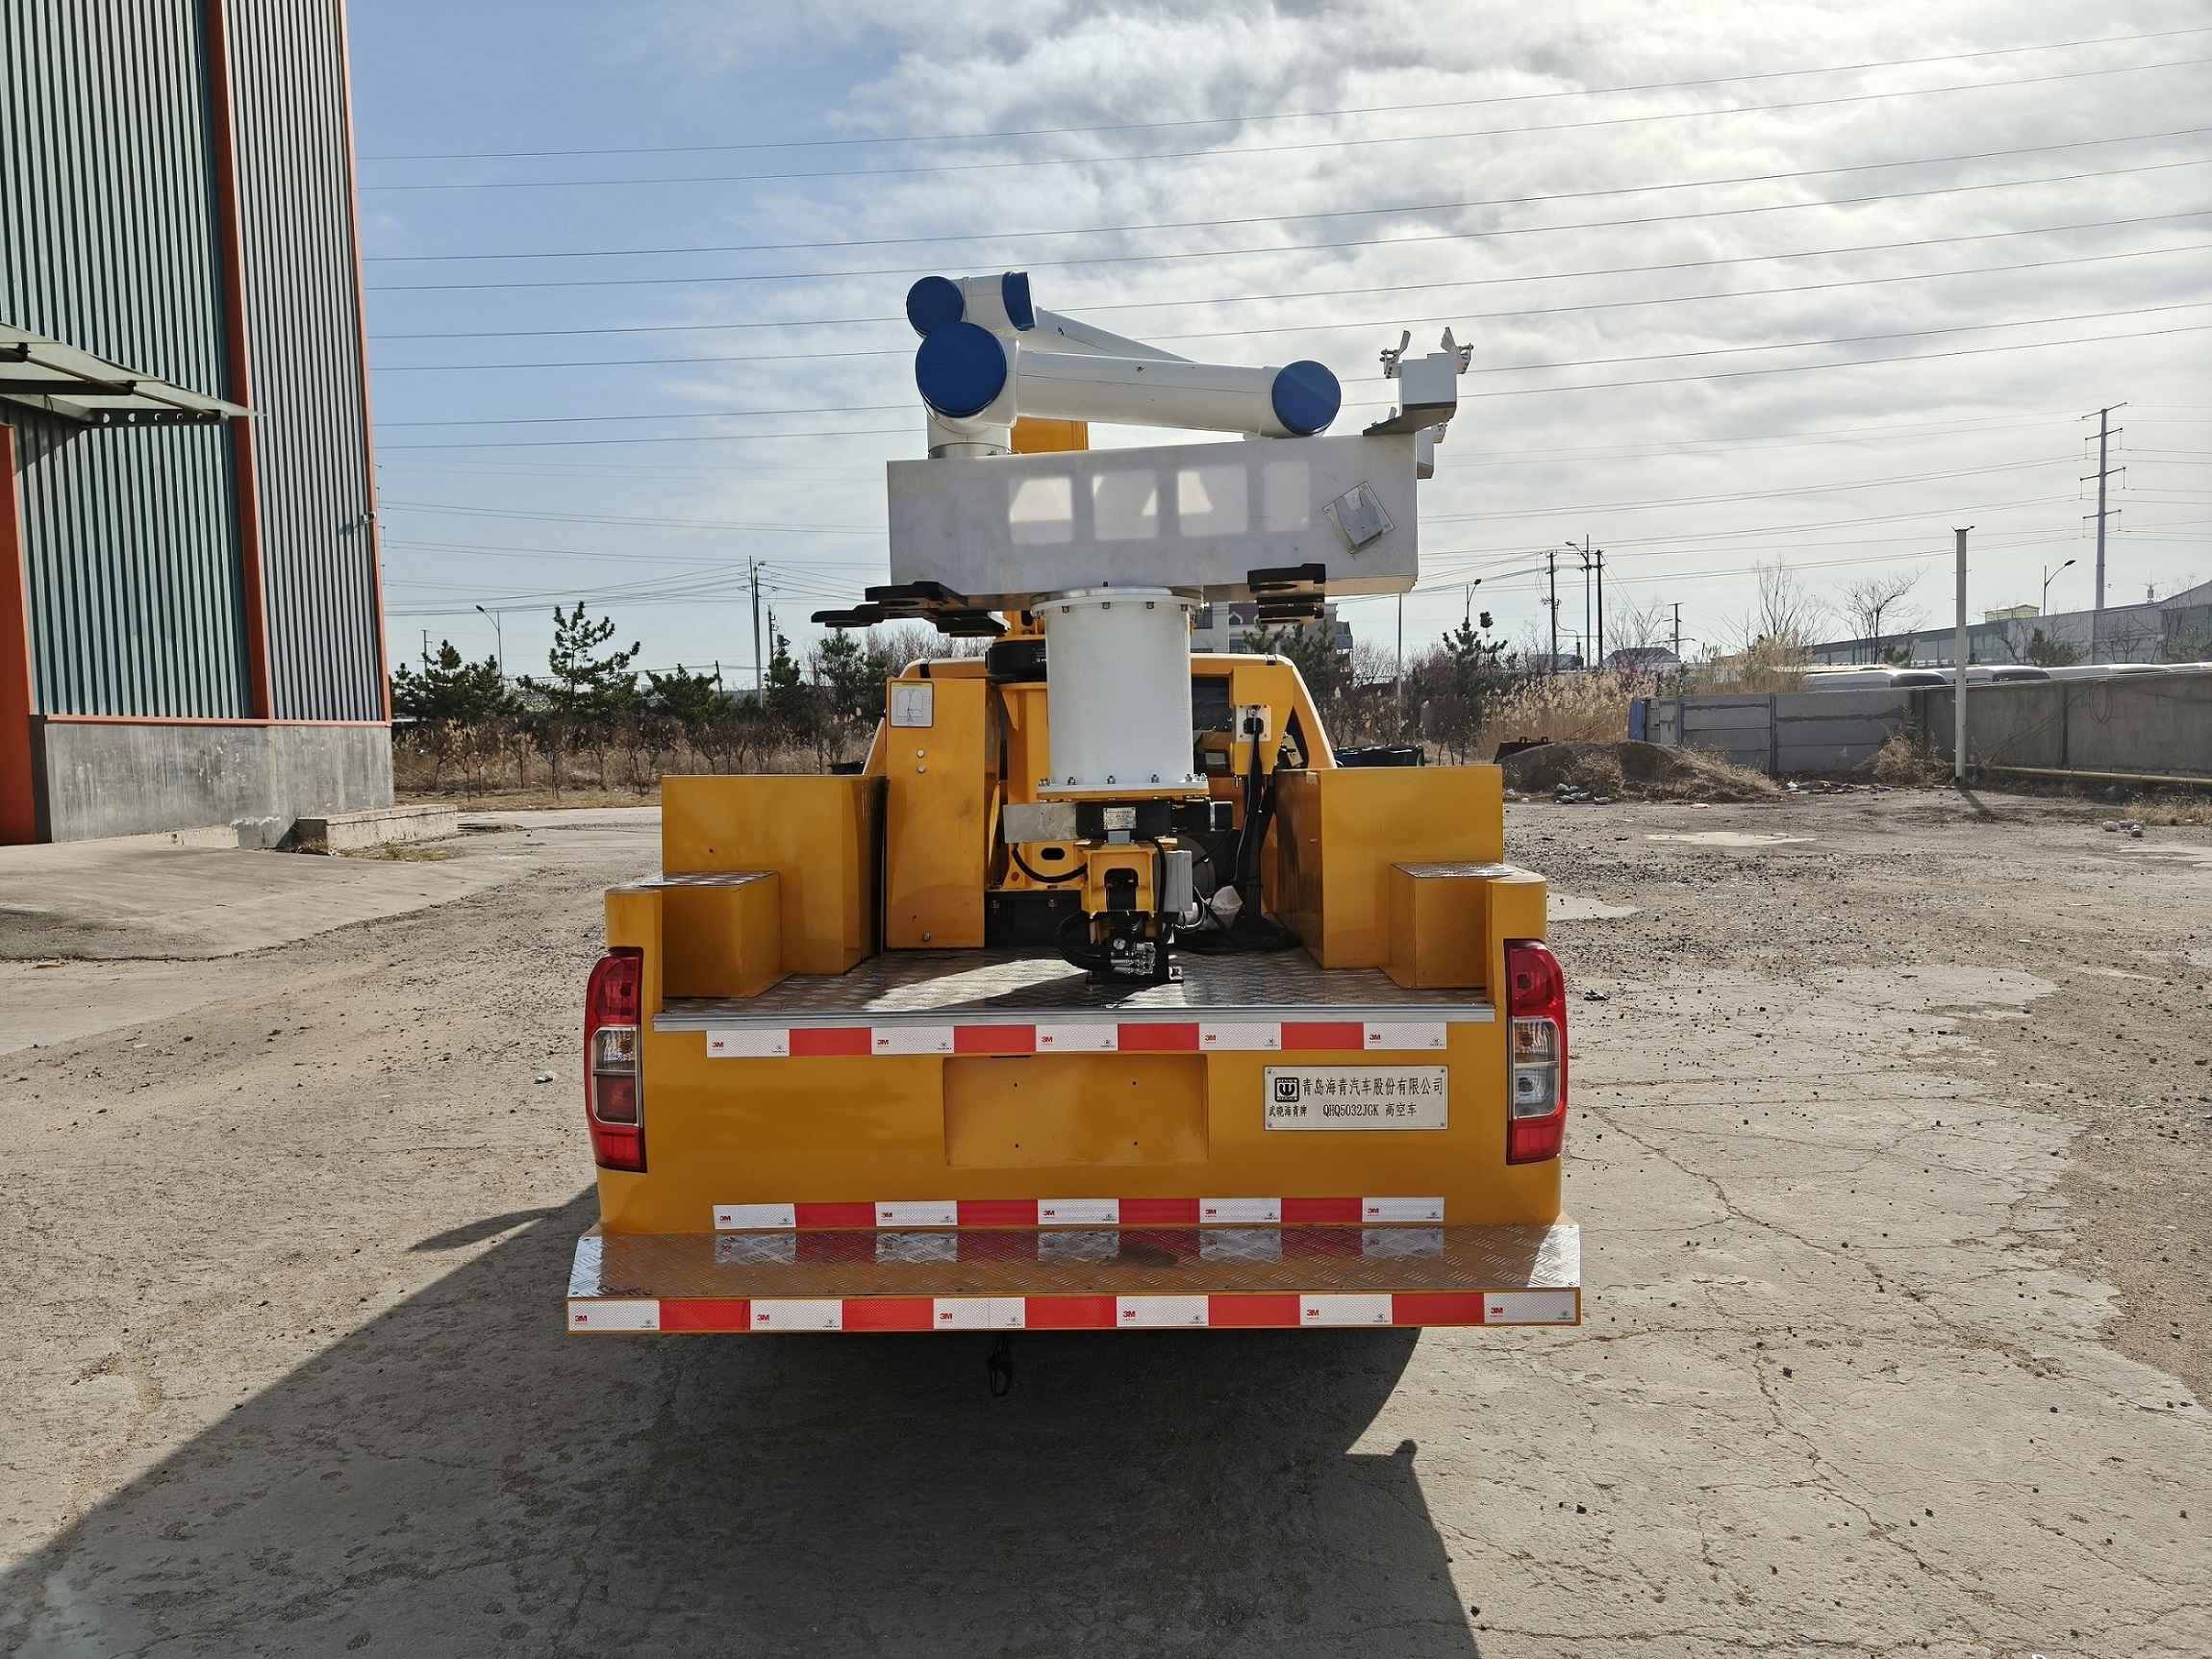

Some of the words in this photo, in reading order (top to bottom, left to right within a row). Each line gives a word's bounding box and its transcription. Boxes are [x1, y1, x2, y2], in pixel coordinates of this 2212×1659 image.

[1302, 1077, 1443, 1095] 青岛海青汽车股份有限公司
[1322, 1103, 1379, 1118] QHQ5032JGK
[1385, 1102, 1417, 1117] 高空车
